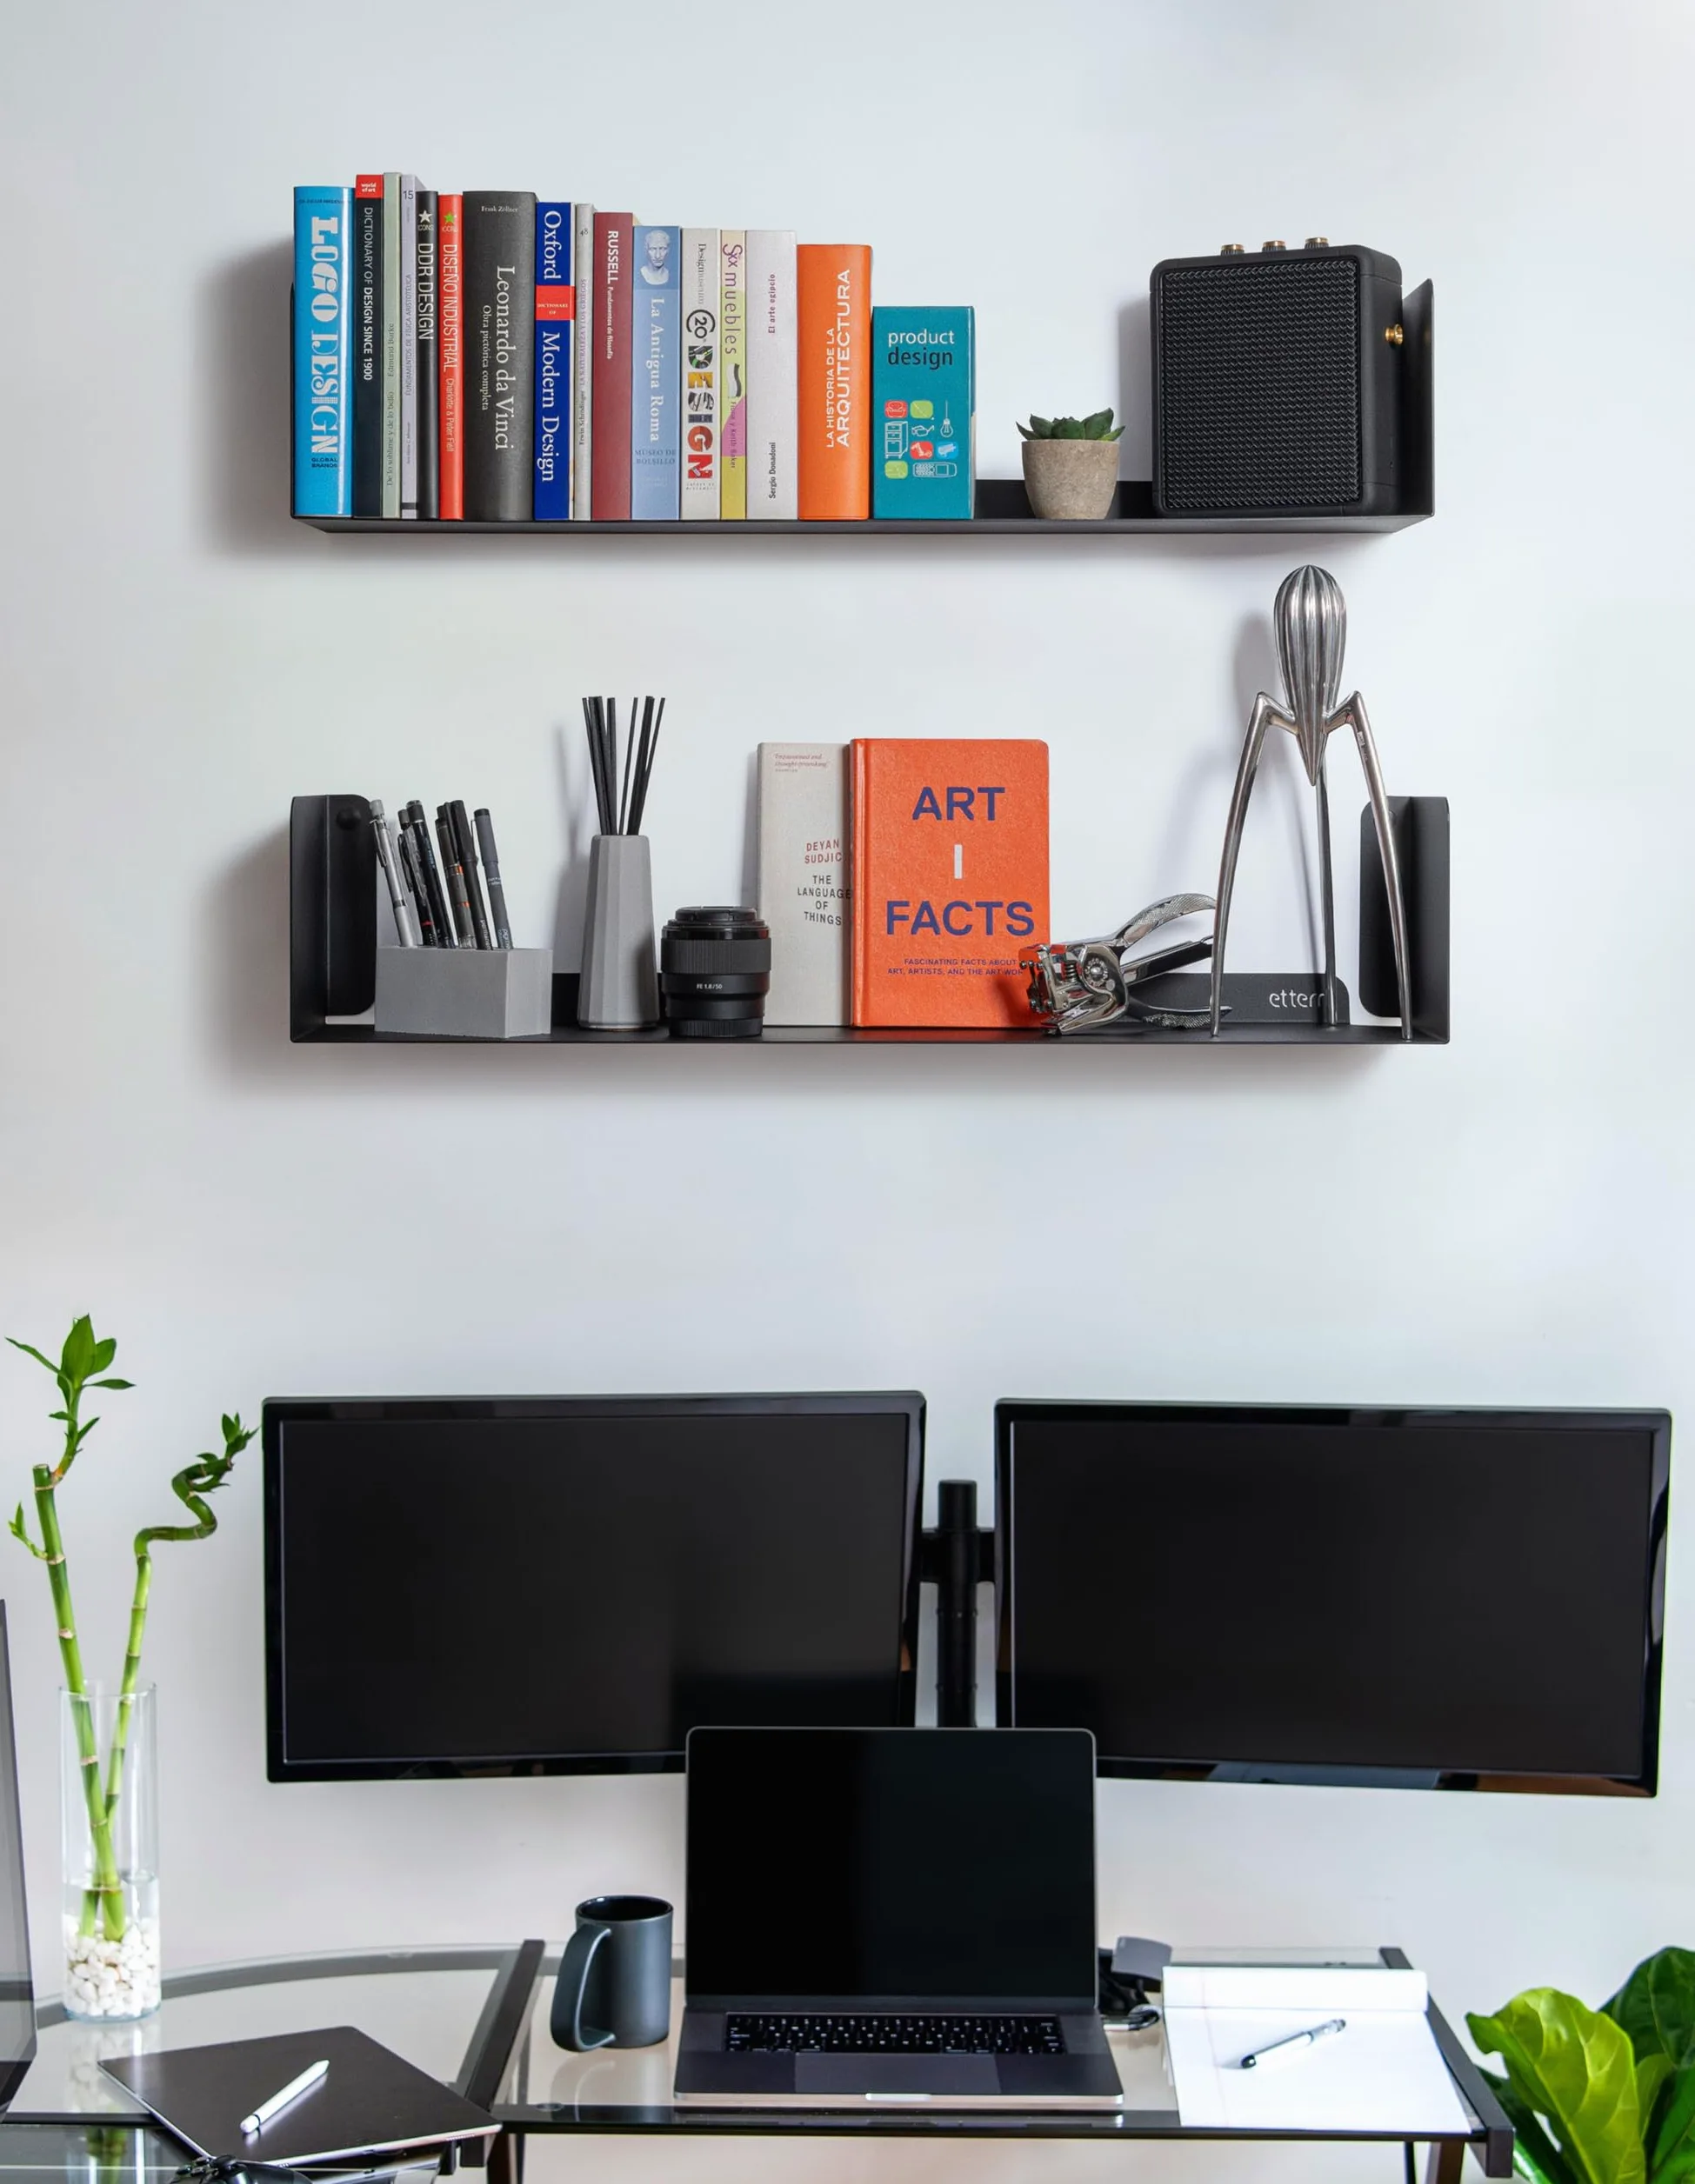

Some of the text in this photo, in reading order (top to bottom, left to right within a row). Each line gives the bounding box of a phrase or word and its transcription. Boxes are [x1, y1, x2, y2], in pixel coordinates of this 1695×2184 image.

[403, 190, 414, 200] 15
[544, 210, 562, 280] Oxford
[607, 230, 618, 284] RUSSELL
[311, 216, 338, 323] LOGO
[443, 244, 459, 293] DISEÑO
[768, 274, 777, 303] egipcio
[363, 207, 373, 381] DICTIONARY OF DESIGN SINCE 1900
[418, 243, 434, 340] DDR DESIGN
[443, 296, 457, 372] INDUSTRIAL
[607, 326, 613, 335] de
[725, 272, 741, 355] muebles
[479, 304, 492, 410] Obra pictórica completa
[495, 265, 517, 450] Leonardo da Vinci
[837, 269, 851, 447] ARQUITECTURA
[887, 346, 953, 370] design
[888, 328, 955, 348] product
[311, 329, 338, 453] DESIGN
[646, 297, 665, 443] La Antigua Roma
[826, 328, 835, 448] LA HISTORIA DE LA
[445, 378, 455, 410] Charlotte
[537, 331, 560, 483] Modern Design
[688, 346, 715, 479] DESIGN
[445, 417, 455, 436] Peter
[768, 476, 777, 499] Sergio
[912, 787, 1005, 821] ART
[804, 852, 843, 864] SUDJIC
[806, 838, 839, 852] DEYAN
[797, 887, 852, 899] LANGUAGE
[812, 875, 831, 884] THE
[804, 911, 842, 926] THINGS
[815, 900, 829, 910] OF
[887, 901, 1035, 936] FACTS
